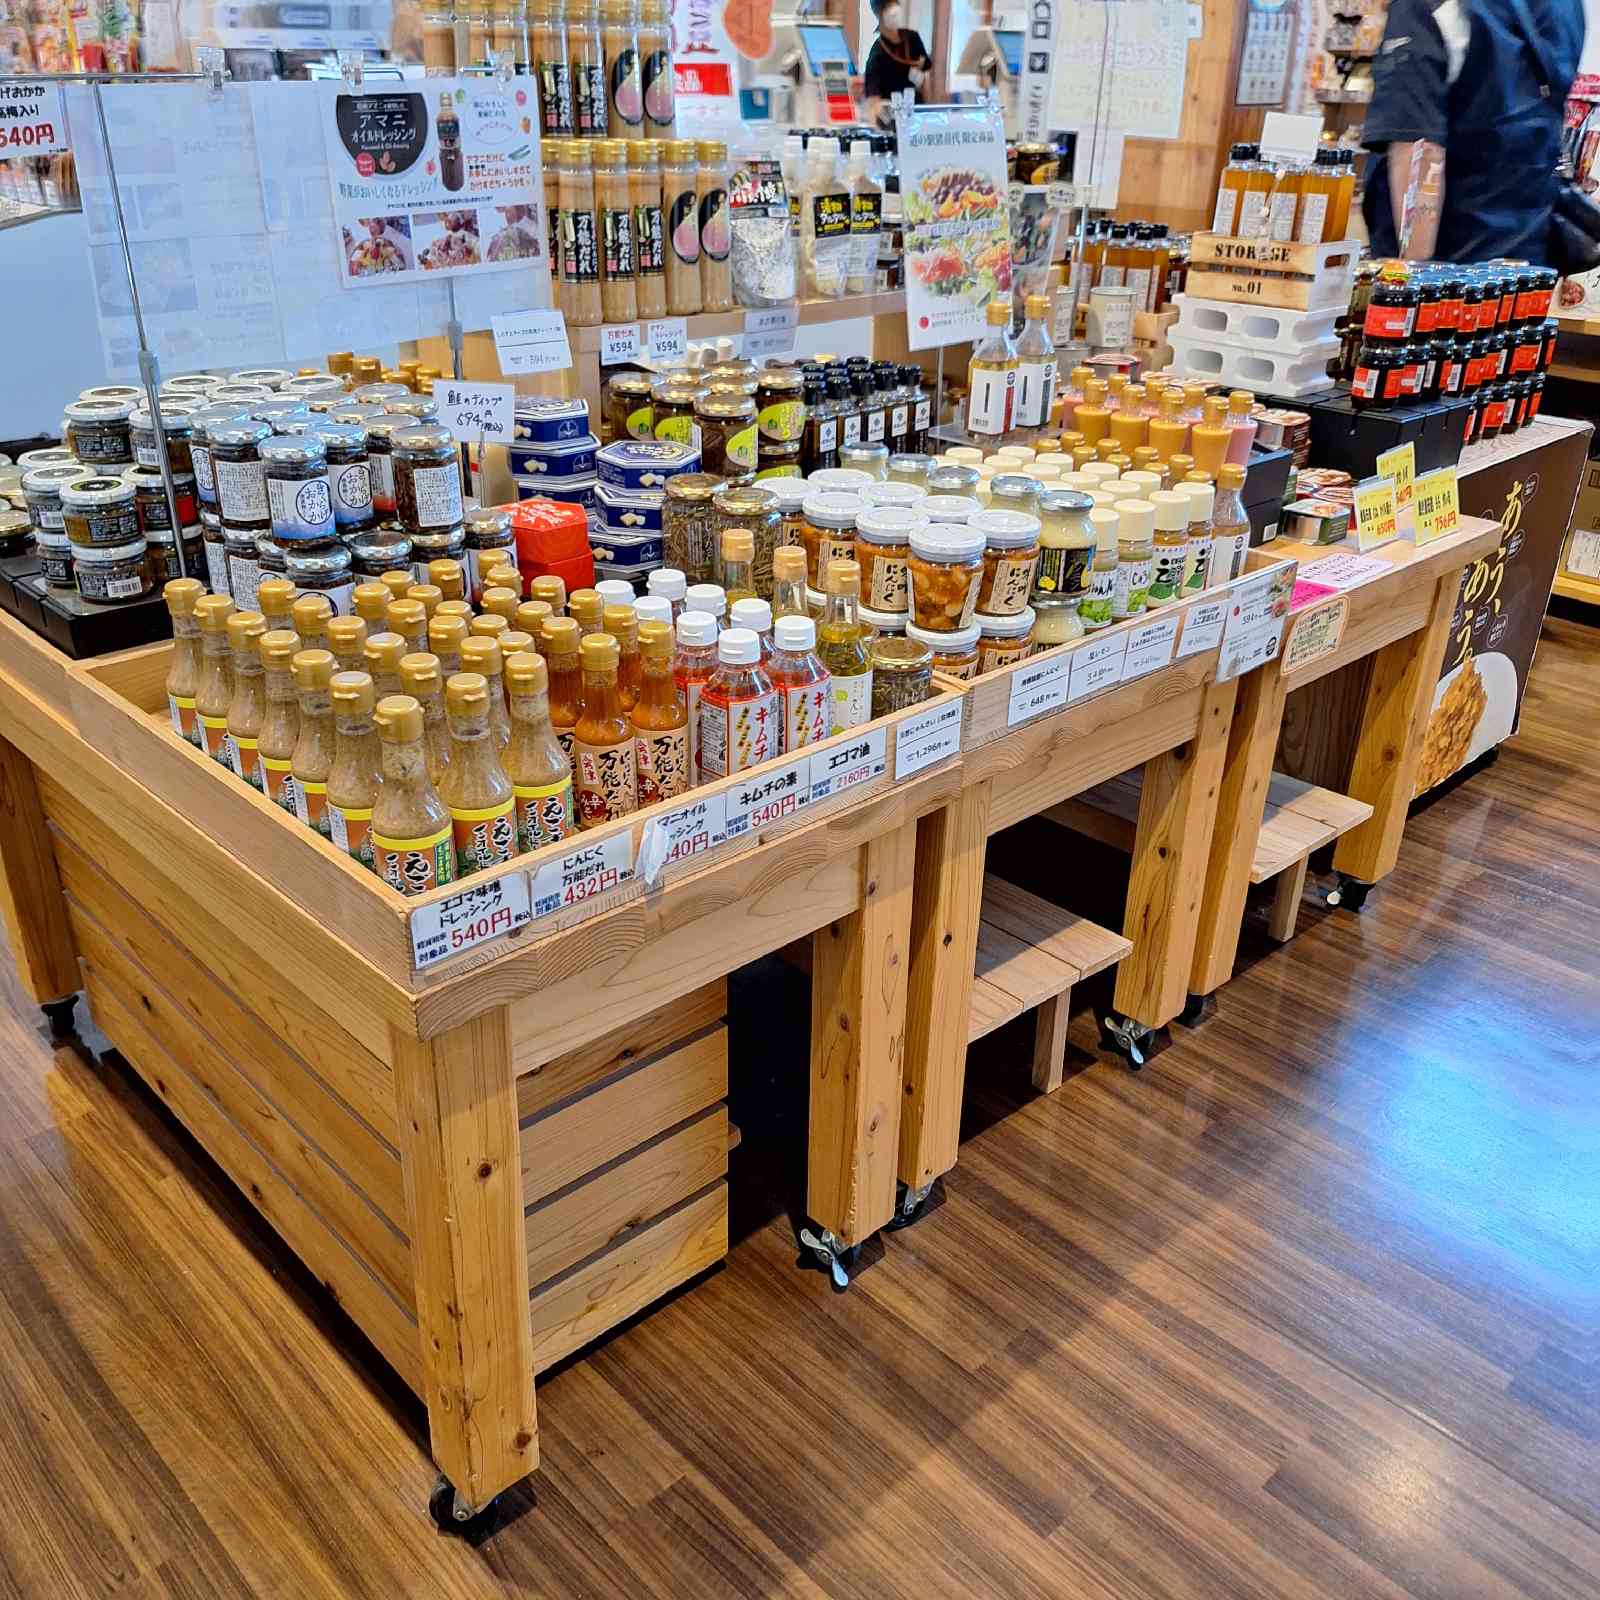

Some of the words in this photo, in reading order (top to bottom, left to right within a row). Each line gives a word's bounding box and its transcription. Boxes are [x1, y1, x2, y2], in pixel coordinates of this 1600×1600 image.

[359, 113, 406, 129] アマニ
[577, 214, 593, 274] 万能だれ
[617, 214, 632, 272] 万能だれ
[1215, 243, 1291, 262] STORGE
[610, 340, 633, 353] ¥594
[655, 339, 678, 352] ¥594
[828, 742, 871, 770] エゴマ油
[740, 771, 798, 806] キムチの素
[751, 793, 796, 827] 540円
[563, 844, 604, 871] にんにく
[662, 831, 709, 865] 40円
[562, 861, 605, 887] 万能だれ
[564, 867, 618, 904] 432円
[440, 879, 502, 914] エゴマ味噌
[440, 892, 504, 929] ドレッシング
[451, 906, 513, 949] 540円
[418, 944, 449, 963] 対象品
